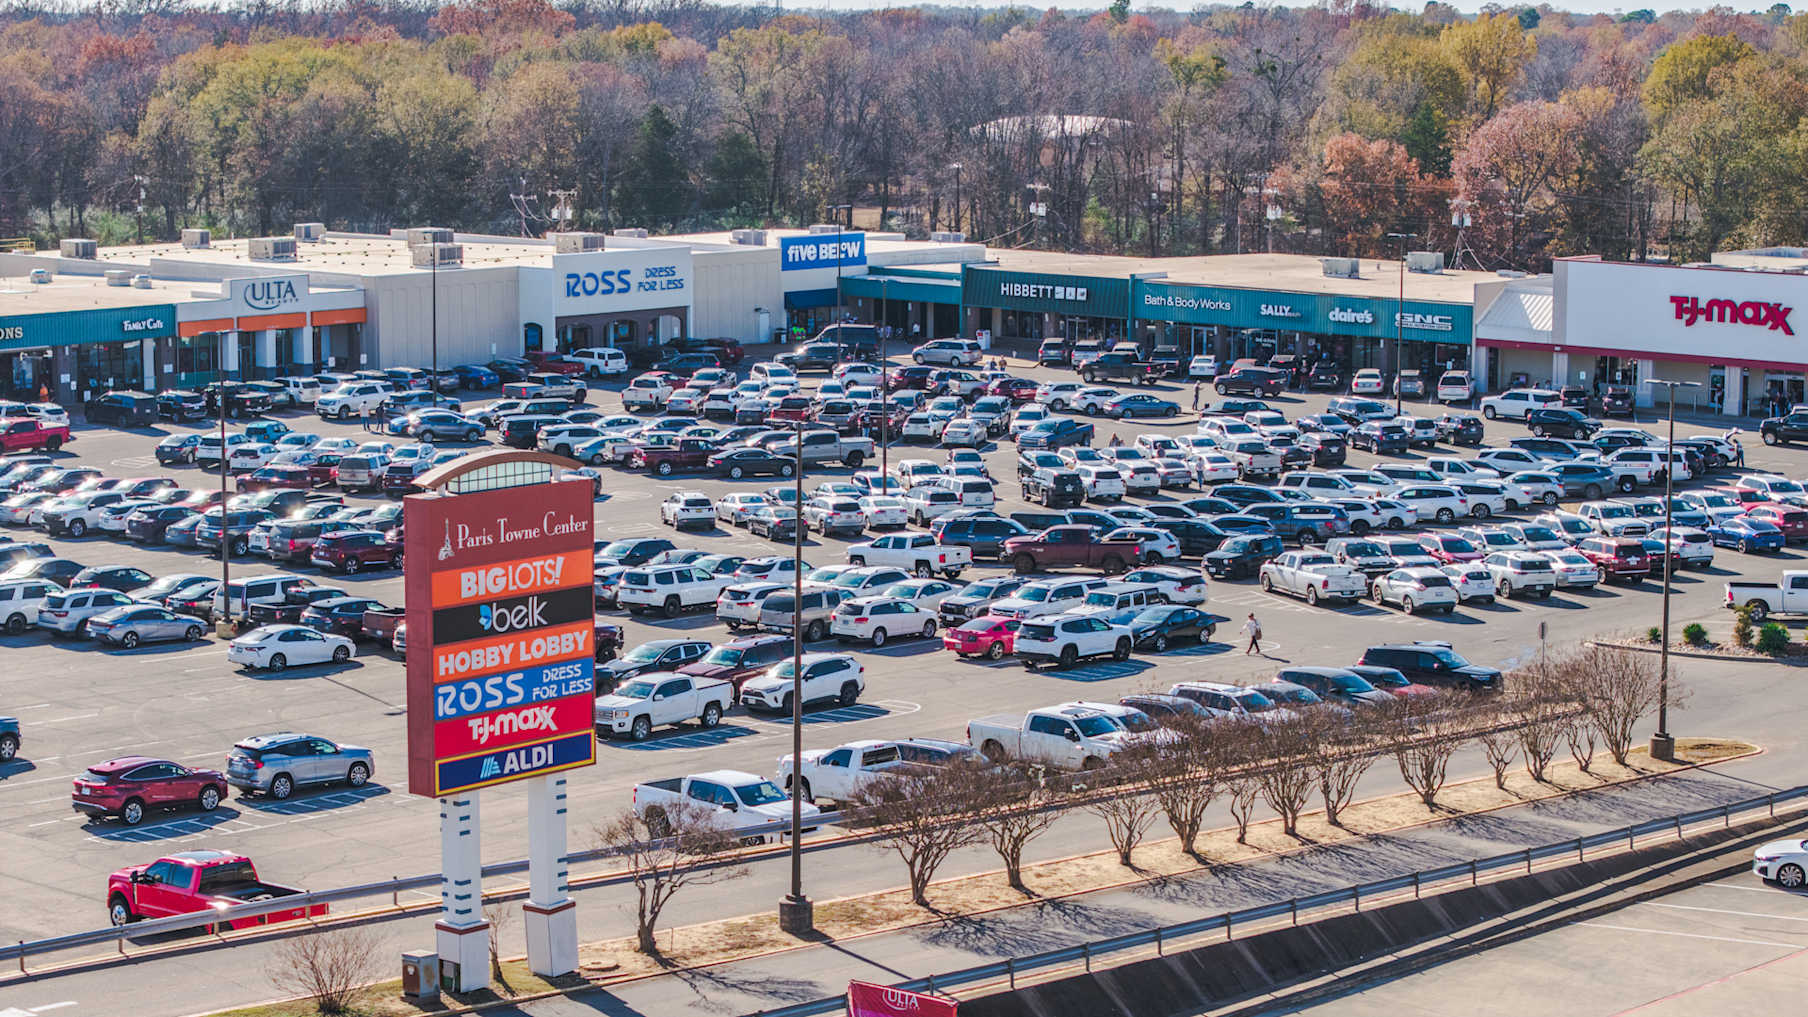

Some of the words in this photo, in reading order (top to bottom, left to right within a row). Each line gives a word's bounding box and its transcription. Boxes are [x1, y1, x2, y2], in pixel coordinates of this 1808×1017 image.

[644, 265, 676, 279] DRESS
[251, 280, 297, 301] ULTA
[566, 269, 631, 297] ROSS
[637, 280, 657, 293] FOR
[659, 278, 684, 292] LESS
[1000, 282, 1053, 299] HIBBETT
[1144, 294, 1167, 306] Bath
[1167, 296, 1175, 307] &
[1175, 298, 1200, 311] Body
[1200, 299, 1231, 311] Works
[1260, 303, 1291, 317] SALLY
[1394, 312, 1453, 326] GNC
[457, 524, 493, 550] Paris
[497, 517, 540, 543] Towne
[543, 510, 588, 535] Center
[492, 596, 548, 633] belk
[438, 642, 514, 677] HOBBY
[519, 630, 589, 662] LOBBY
[542, 663, 582, 684] DRESS
[437, 672, 524, 718] ROSS
[532, 684, 558, 702] FOR
[561, 677, 592, 696] LESS
[503, 743, 554, 775] ALDI
